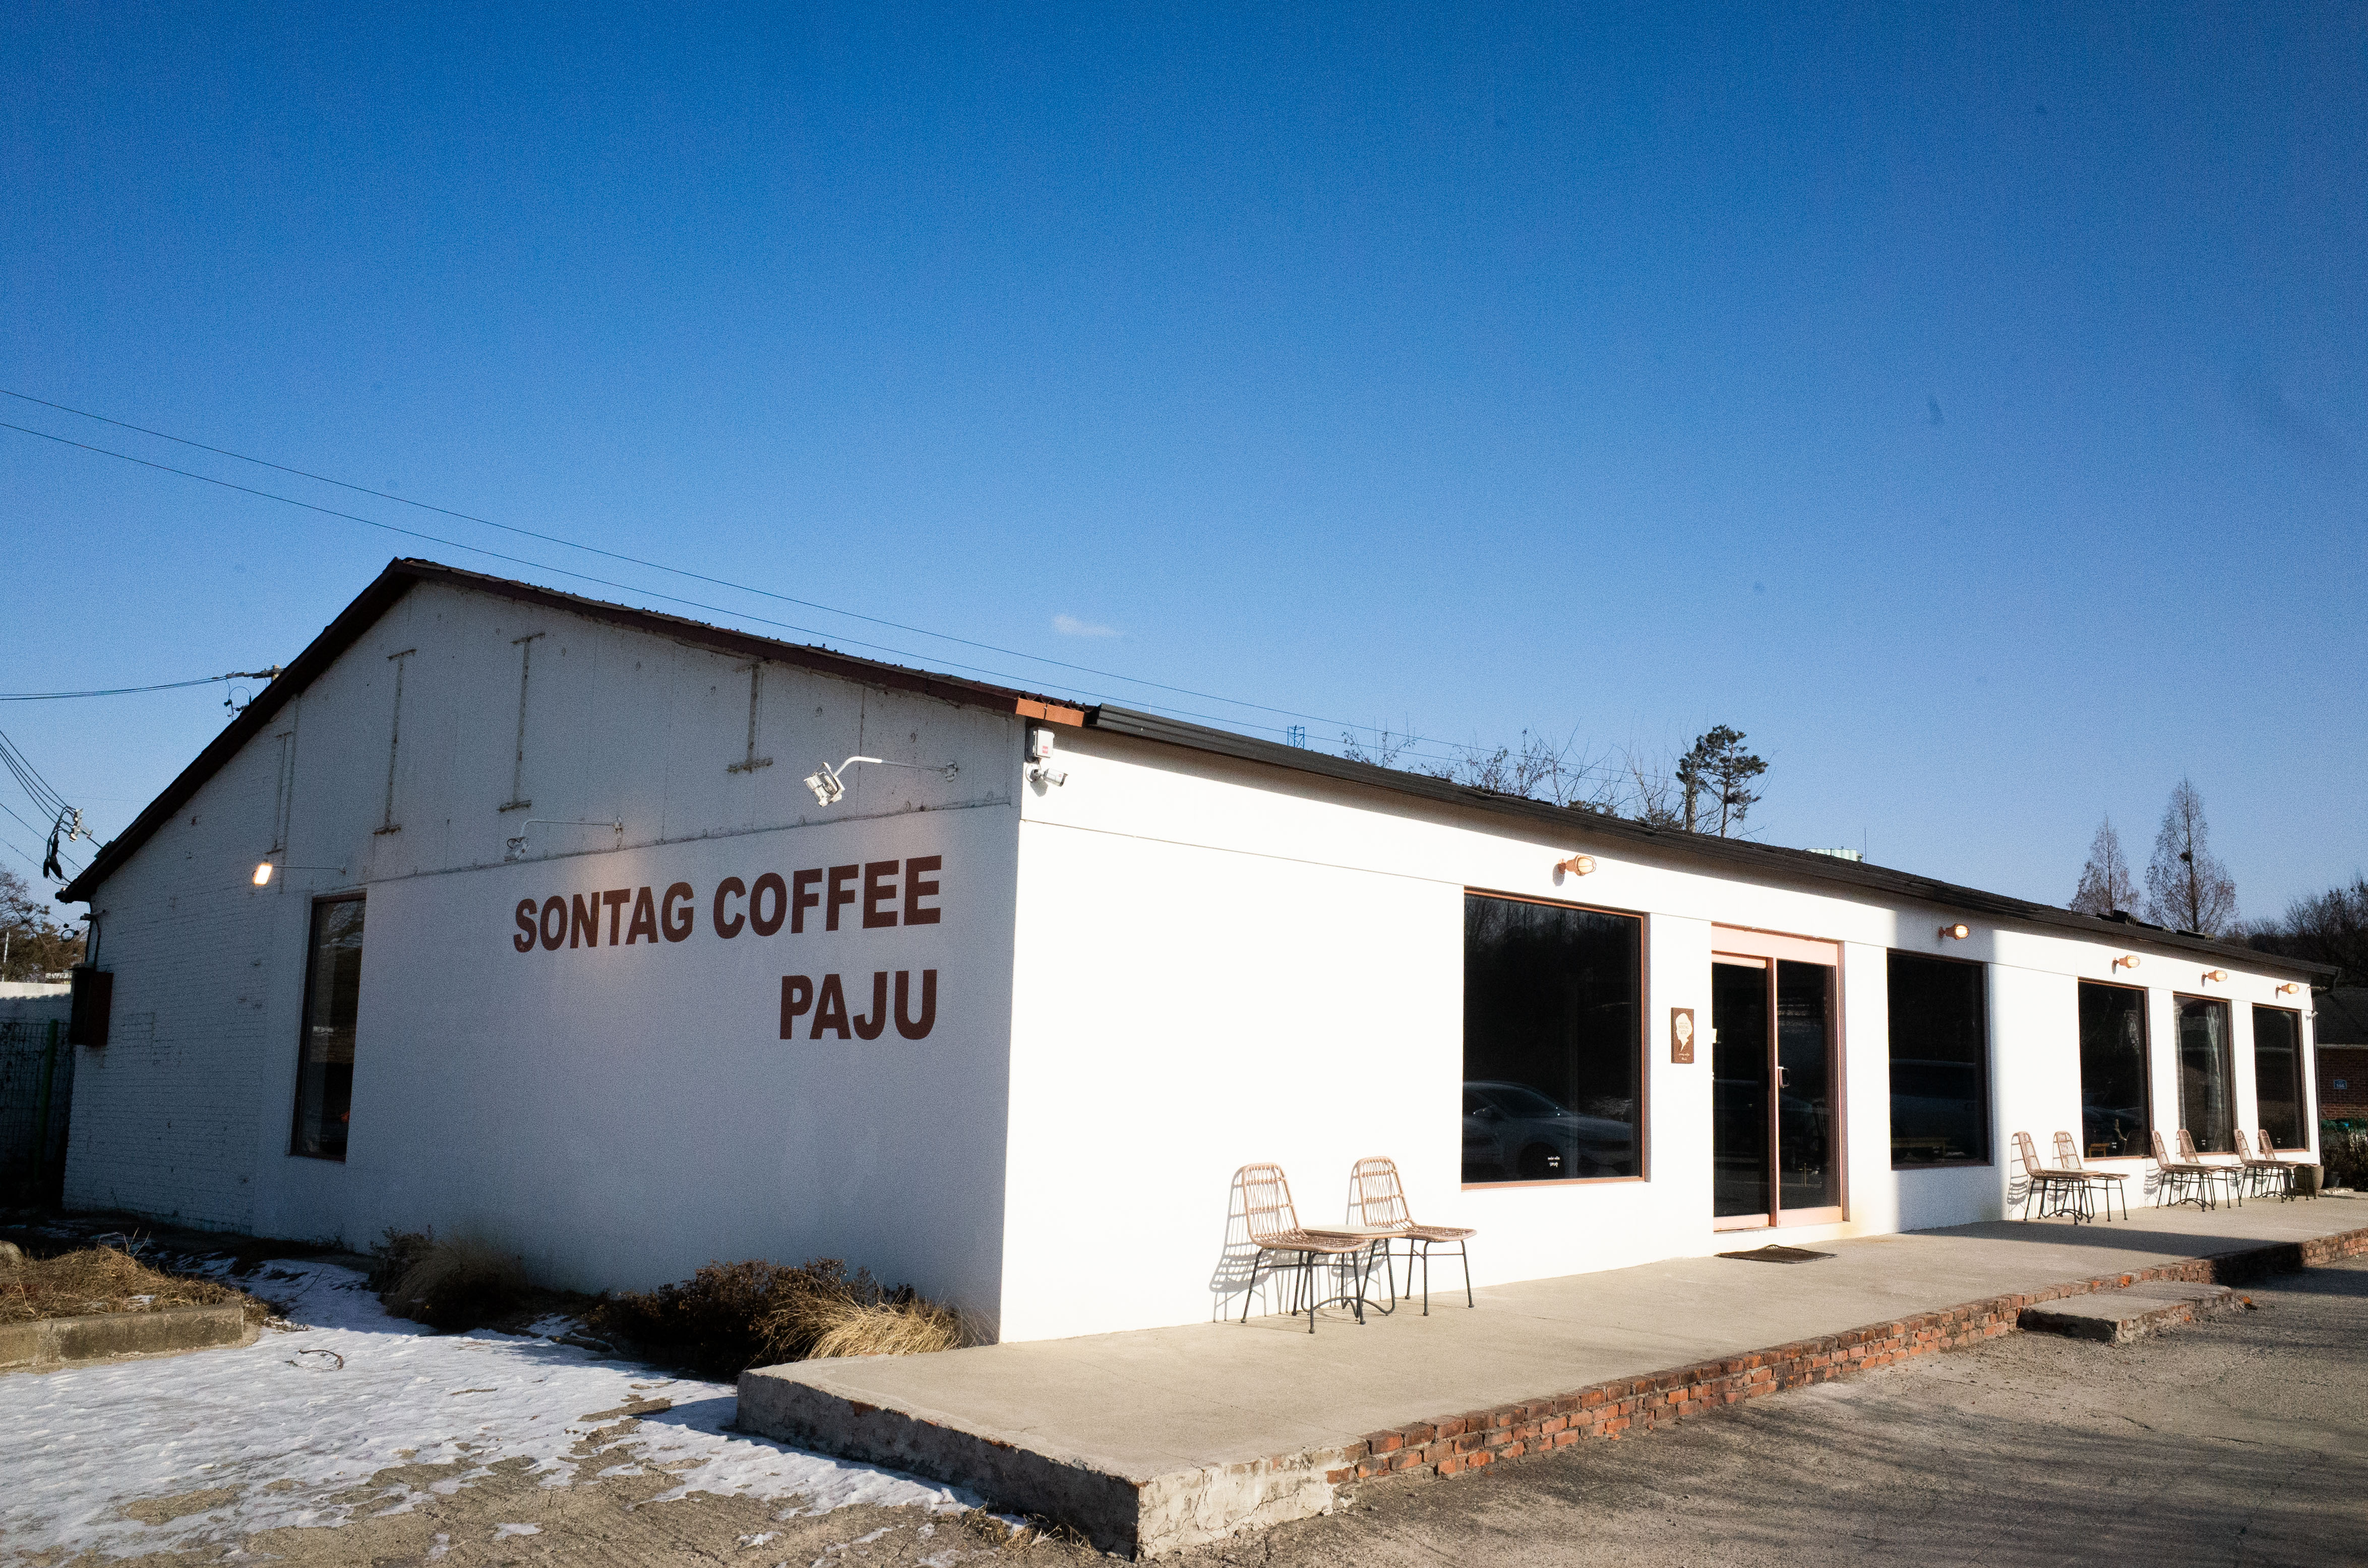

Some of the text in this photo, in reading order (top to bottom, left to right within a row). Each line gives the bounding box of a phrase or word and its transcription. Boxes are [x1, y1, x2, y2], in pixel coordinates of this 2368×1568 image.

[513, 855, 942, 953] SONTAG COFFEE
[780, 969, 937, 1040] PAJU
